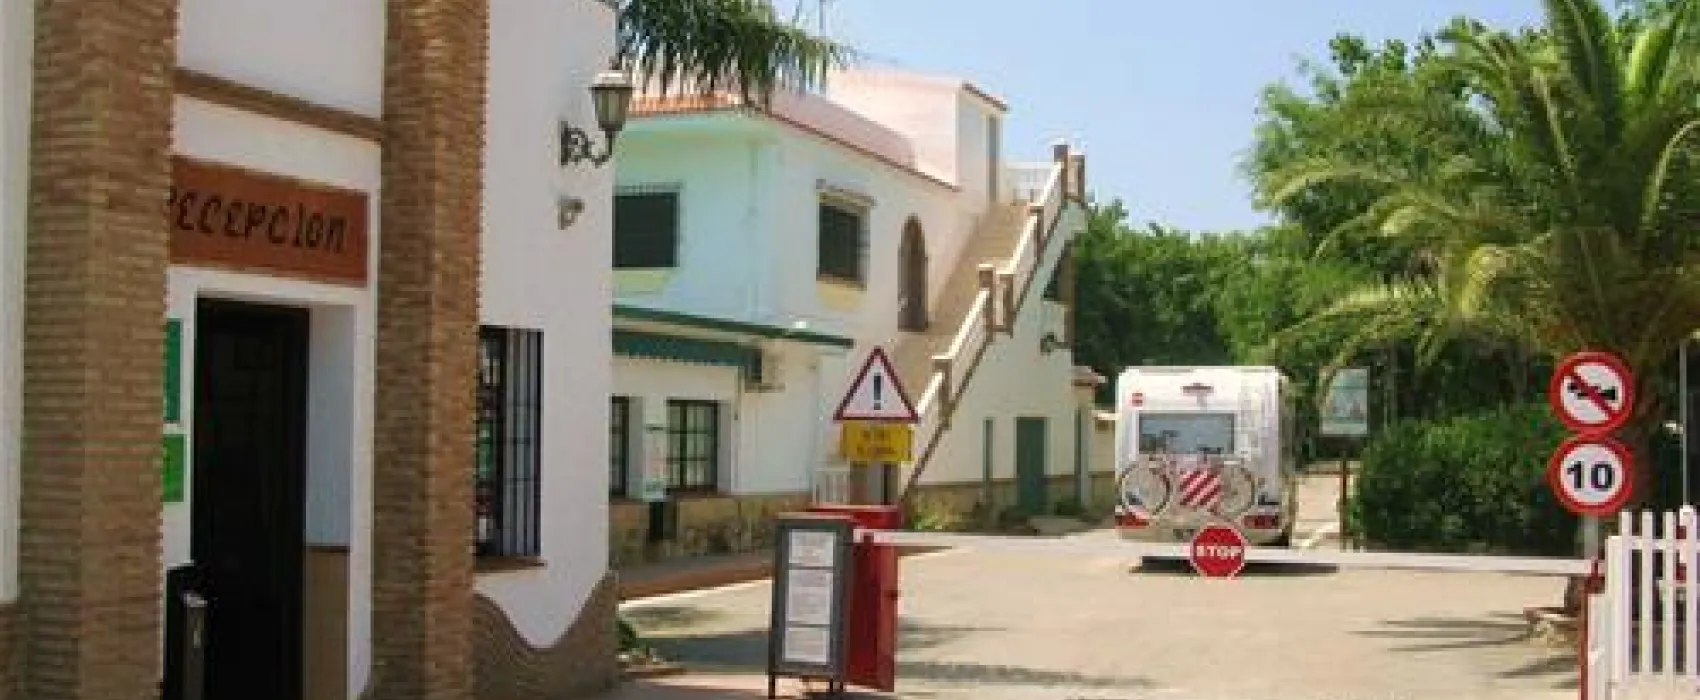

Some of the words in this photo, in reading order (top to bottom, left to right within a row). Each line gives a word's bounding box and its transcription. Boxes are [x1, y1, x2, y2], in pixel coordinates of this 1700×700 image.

[168, 187, 346, 252] ECEPCION
[1566, 461, 1615, 492] 10
[1196, 545, 1242, 561] STOP
